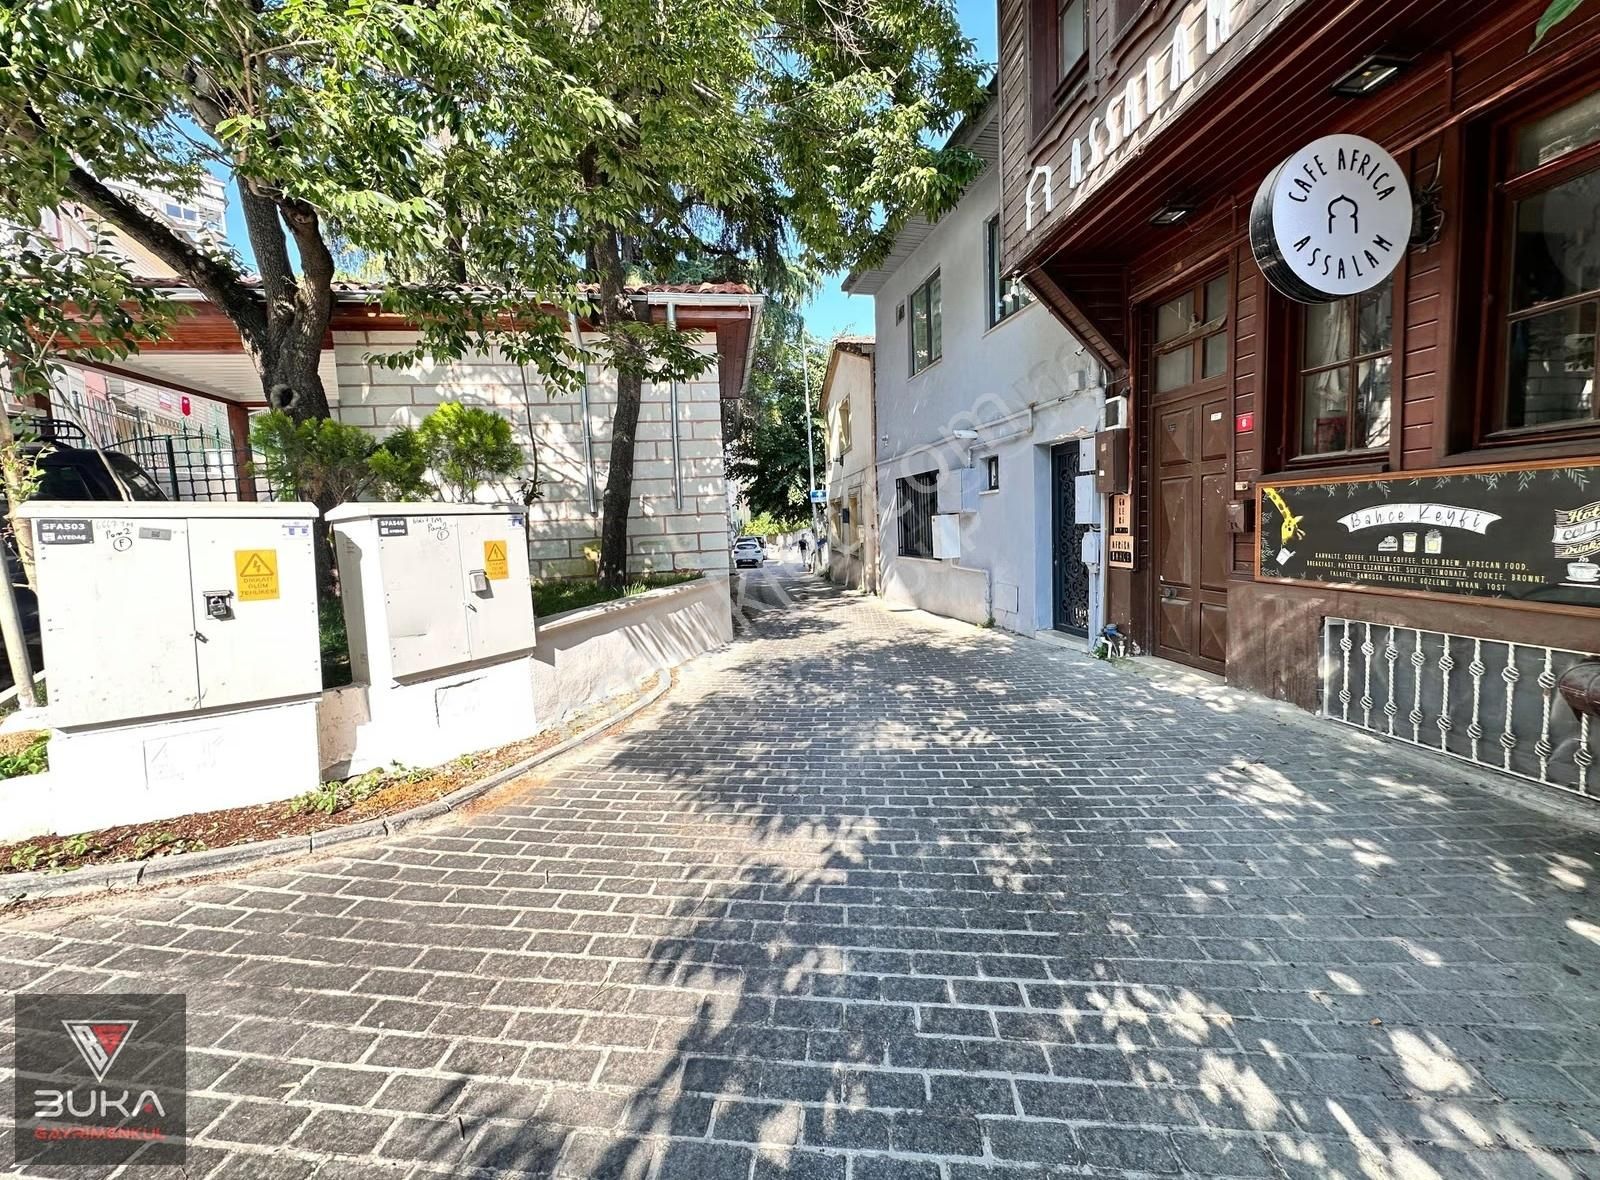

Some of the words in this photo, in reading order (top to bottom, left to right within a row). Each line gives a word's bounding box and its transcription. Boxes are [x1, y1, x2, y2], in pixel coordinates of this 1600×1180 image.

[1288, 154, 1328, 203] CAFE
[1337, 147, 1396, 201] AFRICA
[1293, 233, 1393, 280] ASSALAM
[1421, 557, 1438, 565] COLD
[1466, 560, 1500, 569] AFRICAN
[1486, 582, 1506, 591] TOST
